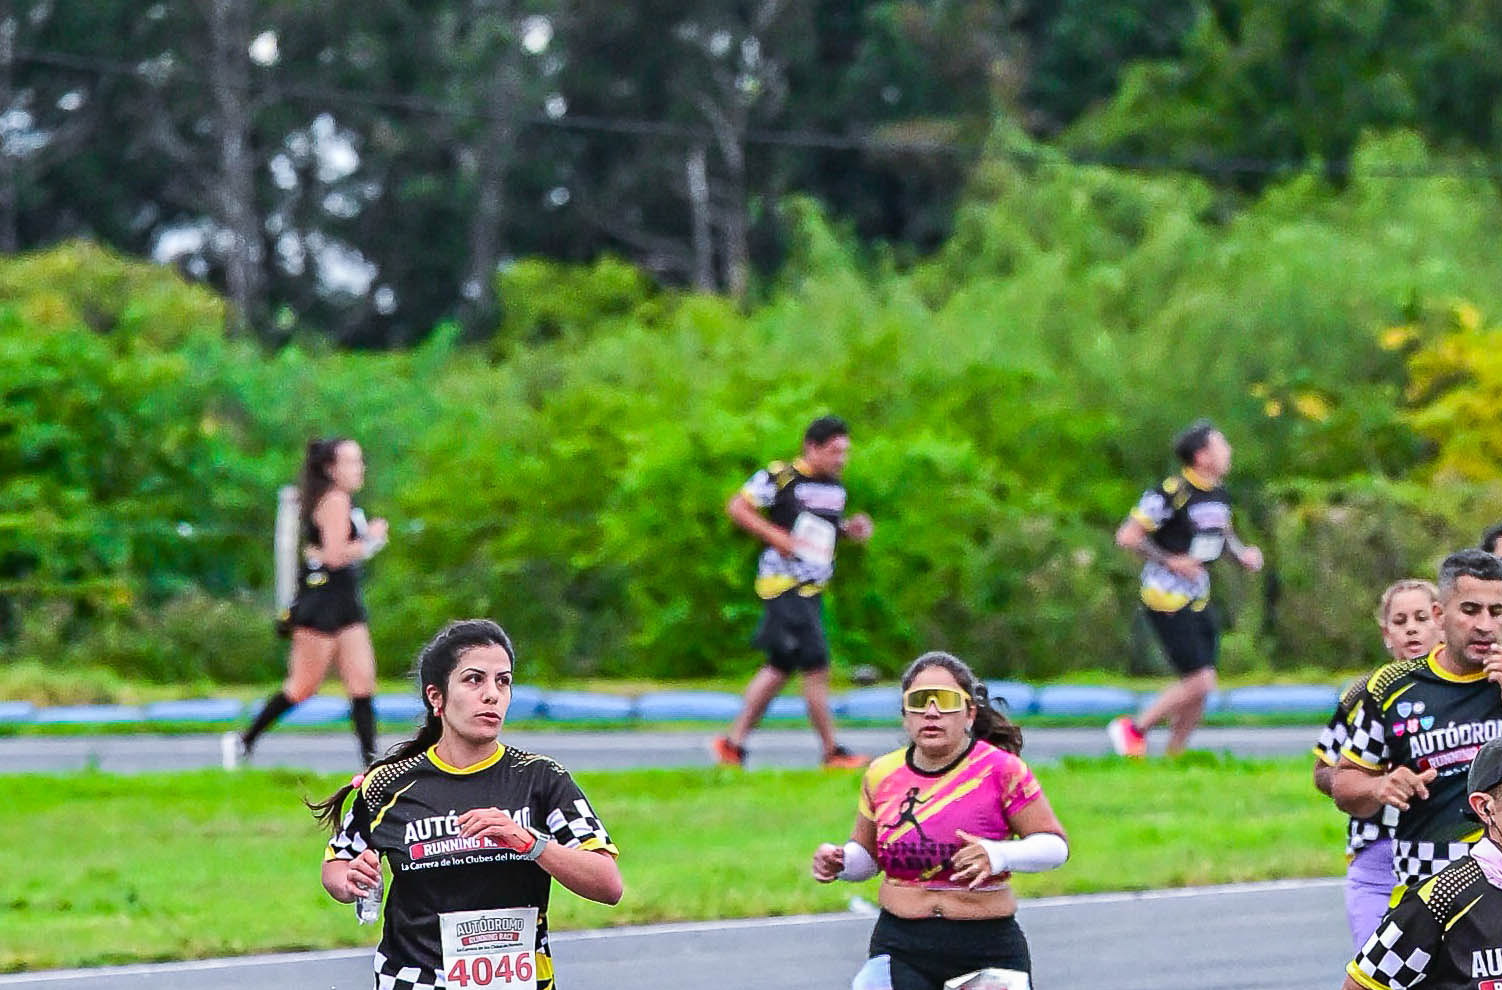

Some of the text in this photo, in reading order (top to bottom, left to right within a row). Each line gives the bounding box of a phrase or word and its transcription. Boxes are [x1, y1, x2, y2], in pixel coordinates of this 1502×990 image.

[423, 837, 481, 857] RUNNING
[401, 863, 409, 871] La
[410, 862, 439, 871] Carrera
[441, 858, 451, 867] de
[452, 858, 465, 866] los
[466, 855, 493, 864] Clubes
[494, 853, 508, 861] del
[456, 915, 525, 937] AUTÓDROMO
[447, 952, 533, 987] 4046
